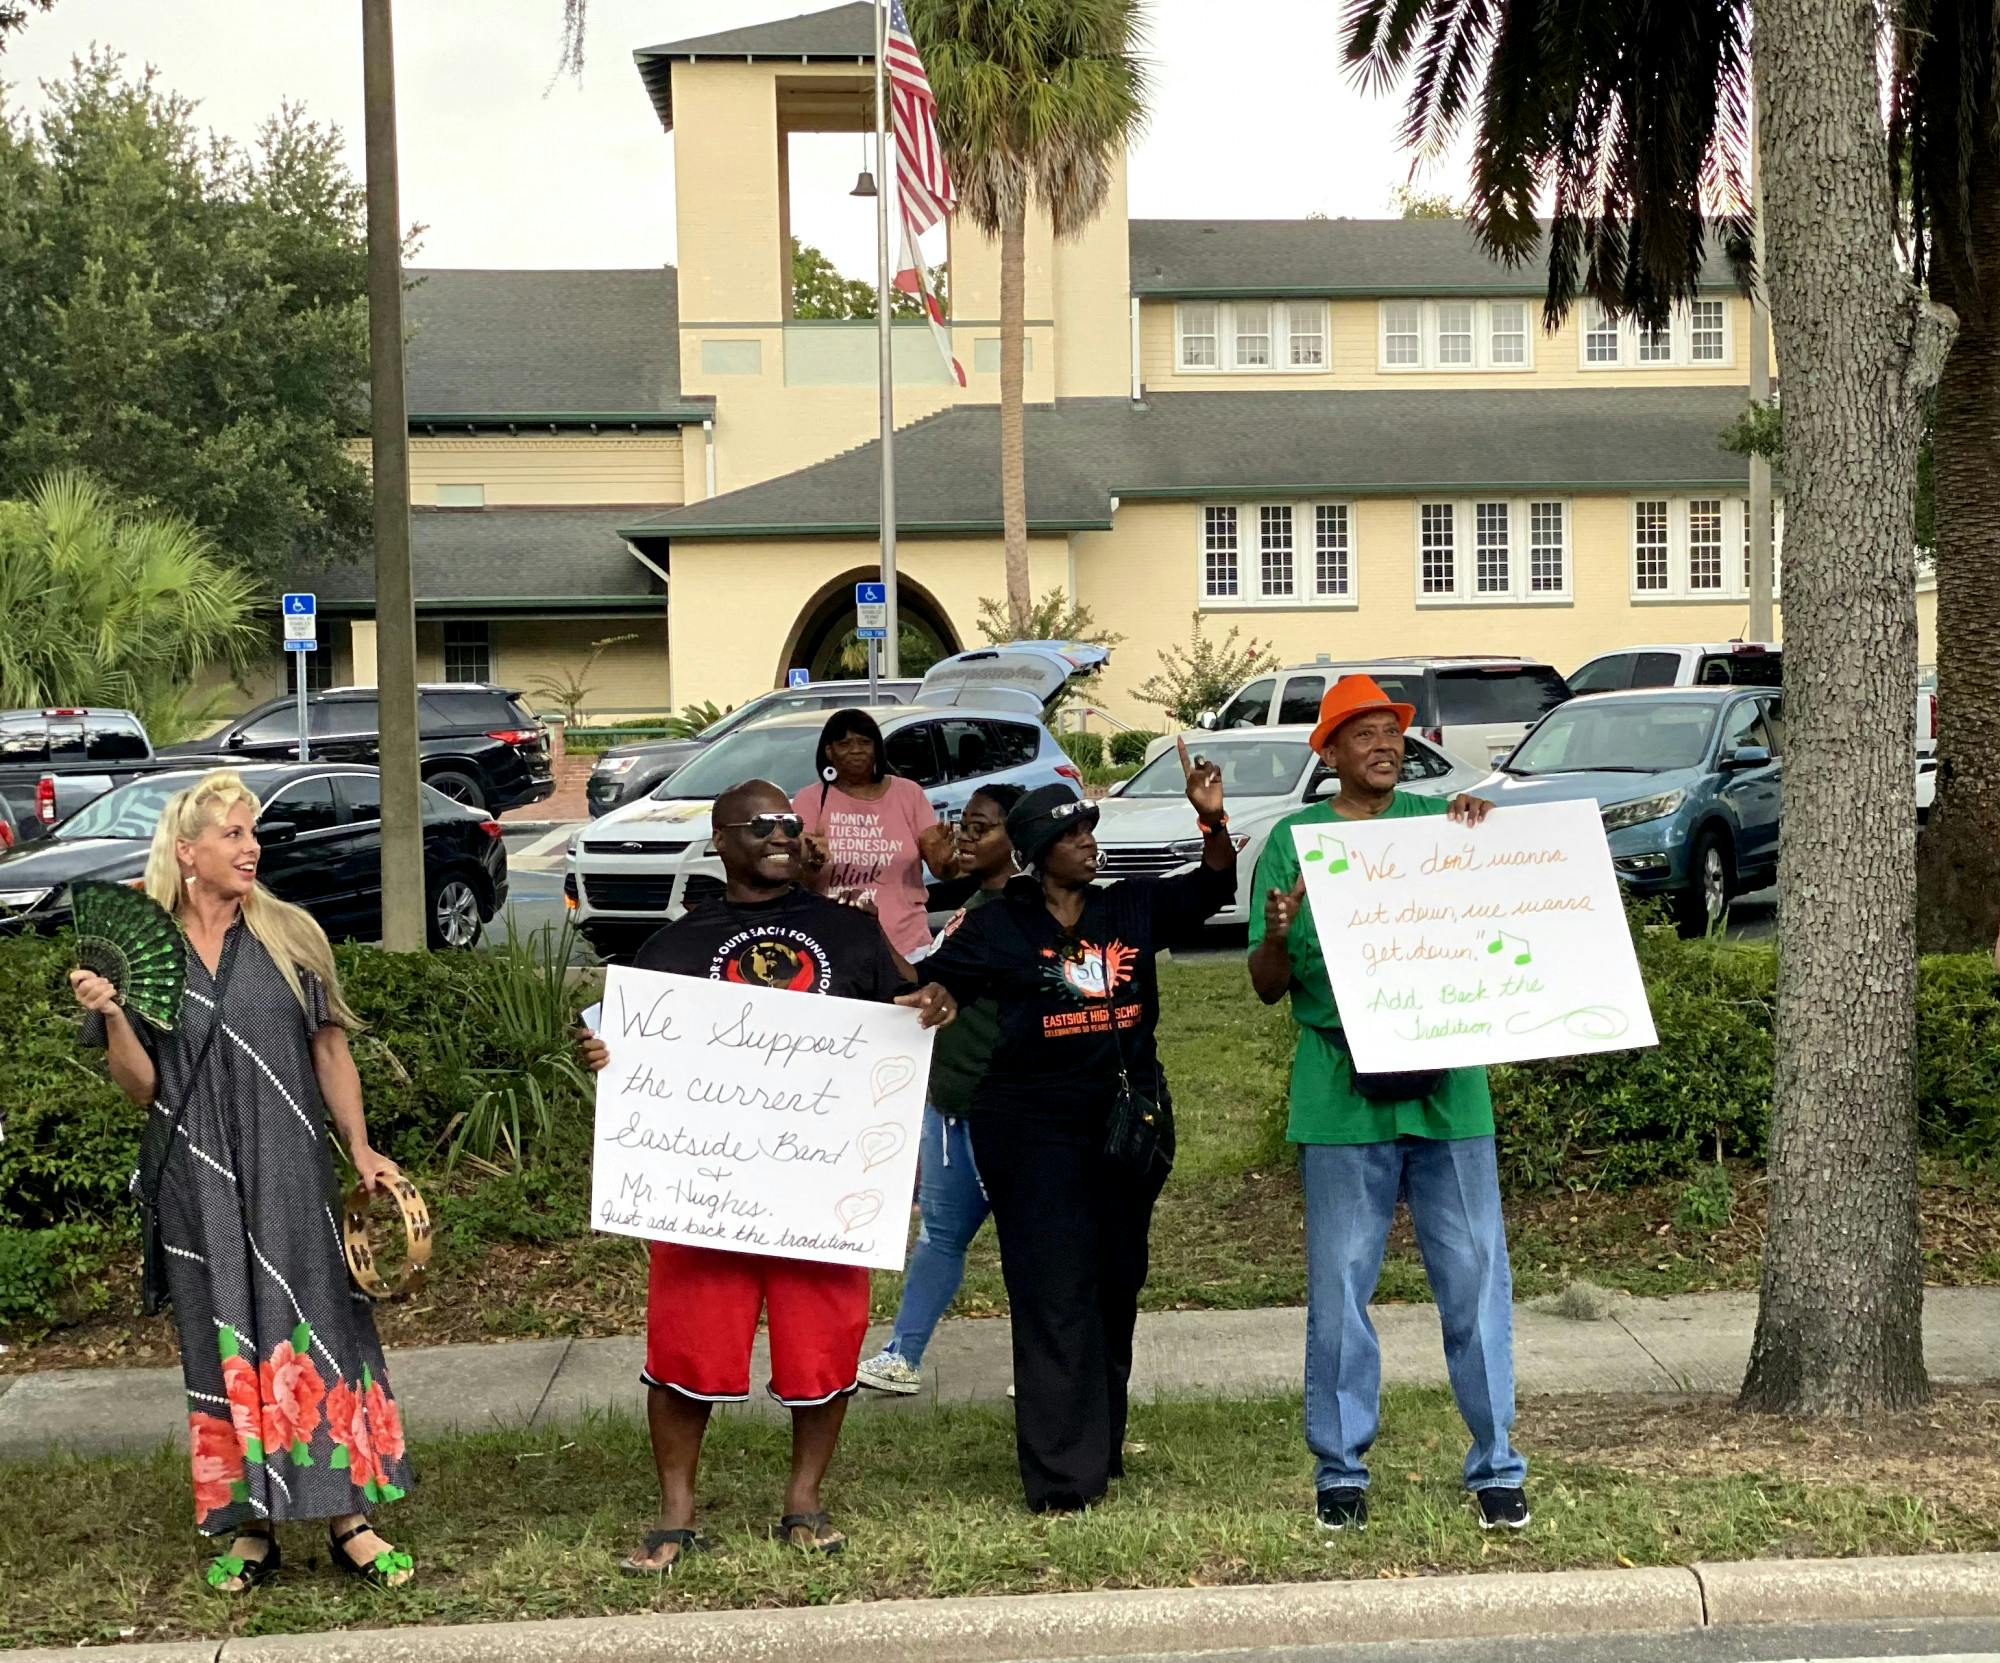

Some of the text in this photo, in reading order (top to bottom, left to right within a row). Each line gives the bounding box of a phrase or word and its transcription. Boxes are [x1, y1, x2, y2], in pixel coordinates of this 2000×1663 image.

[829, 825, 884, 838] TUESDAY
[830, 812, 880, 826] MONDAY
[828, 839, 903, 852] WEDNESDAY
[1420, 842, 1482, 875] don't
[1487, 849, 1567, 868] wanna
[829, 862, 888, 887] blink
[1348, 903, 1389, 928] sit
[1461, 903, 1507, 919] we
[1511, 895, 1595, 915] wanna
[718, 926, 785, 956] OUTREACH
[1362, 936, 1406, 976] get
[1367, 975, 1545, 1012] Add Back the
[619, 985, 869, 1069] We Support
[1043, 1011, 1088, 1028] EASTSIDE
[620, 1064, 840, 1115] the current
[604, 1111, 850, 1165] Eastside Band
[620, 1172, 656, 1207] Mr.
[600, 1200, 643, 1227] Just
[647, 1216, 677, 1232] add
[682, 1218, 727, 1238] back
[732, 1225, 770, 1245] the
